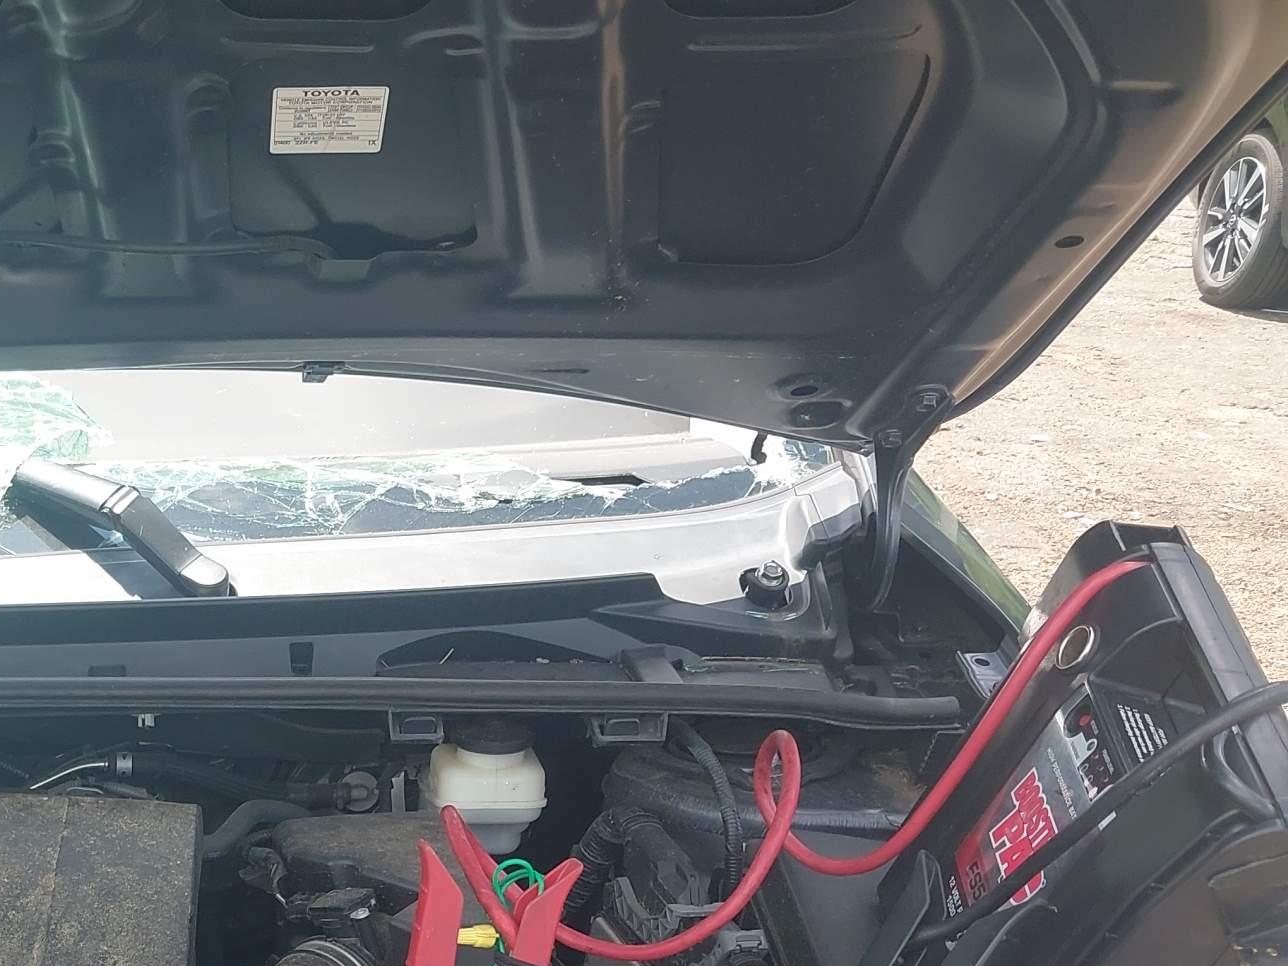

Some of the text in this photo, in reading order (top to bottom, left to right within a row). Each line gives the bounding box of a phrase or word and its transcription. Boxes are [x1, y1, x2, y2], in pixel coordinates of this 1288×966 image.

[303, 89, 360, 97] TOYOTA
[969, 861, 986, 900] ES5
[951, 886, 962, 908] VOLT
